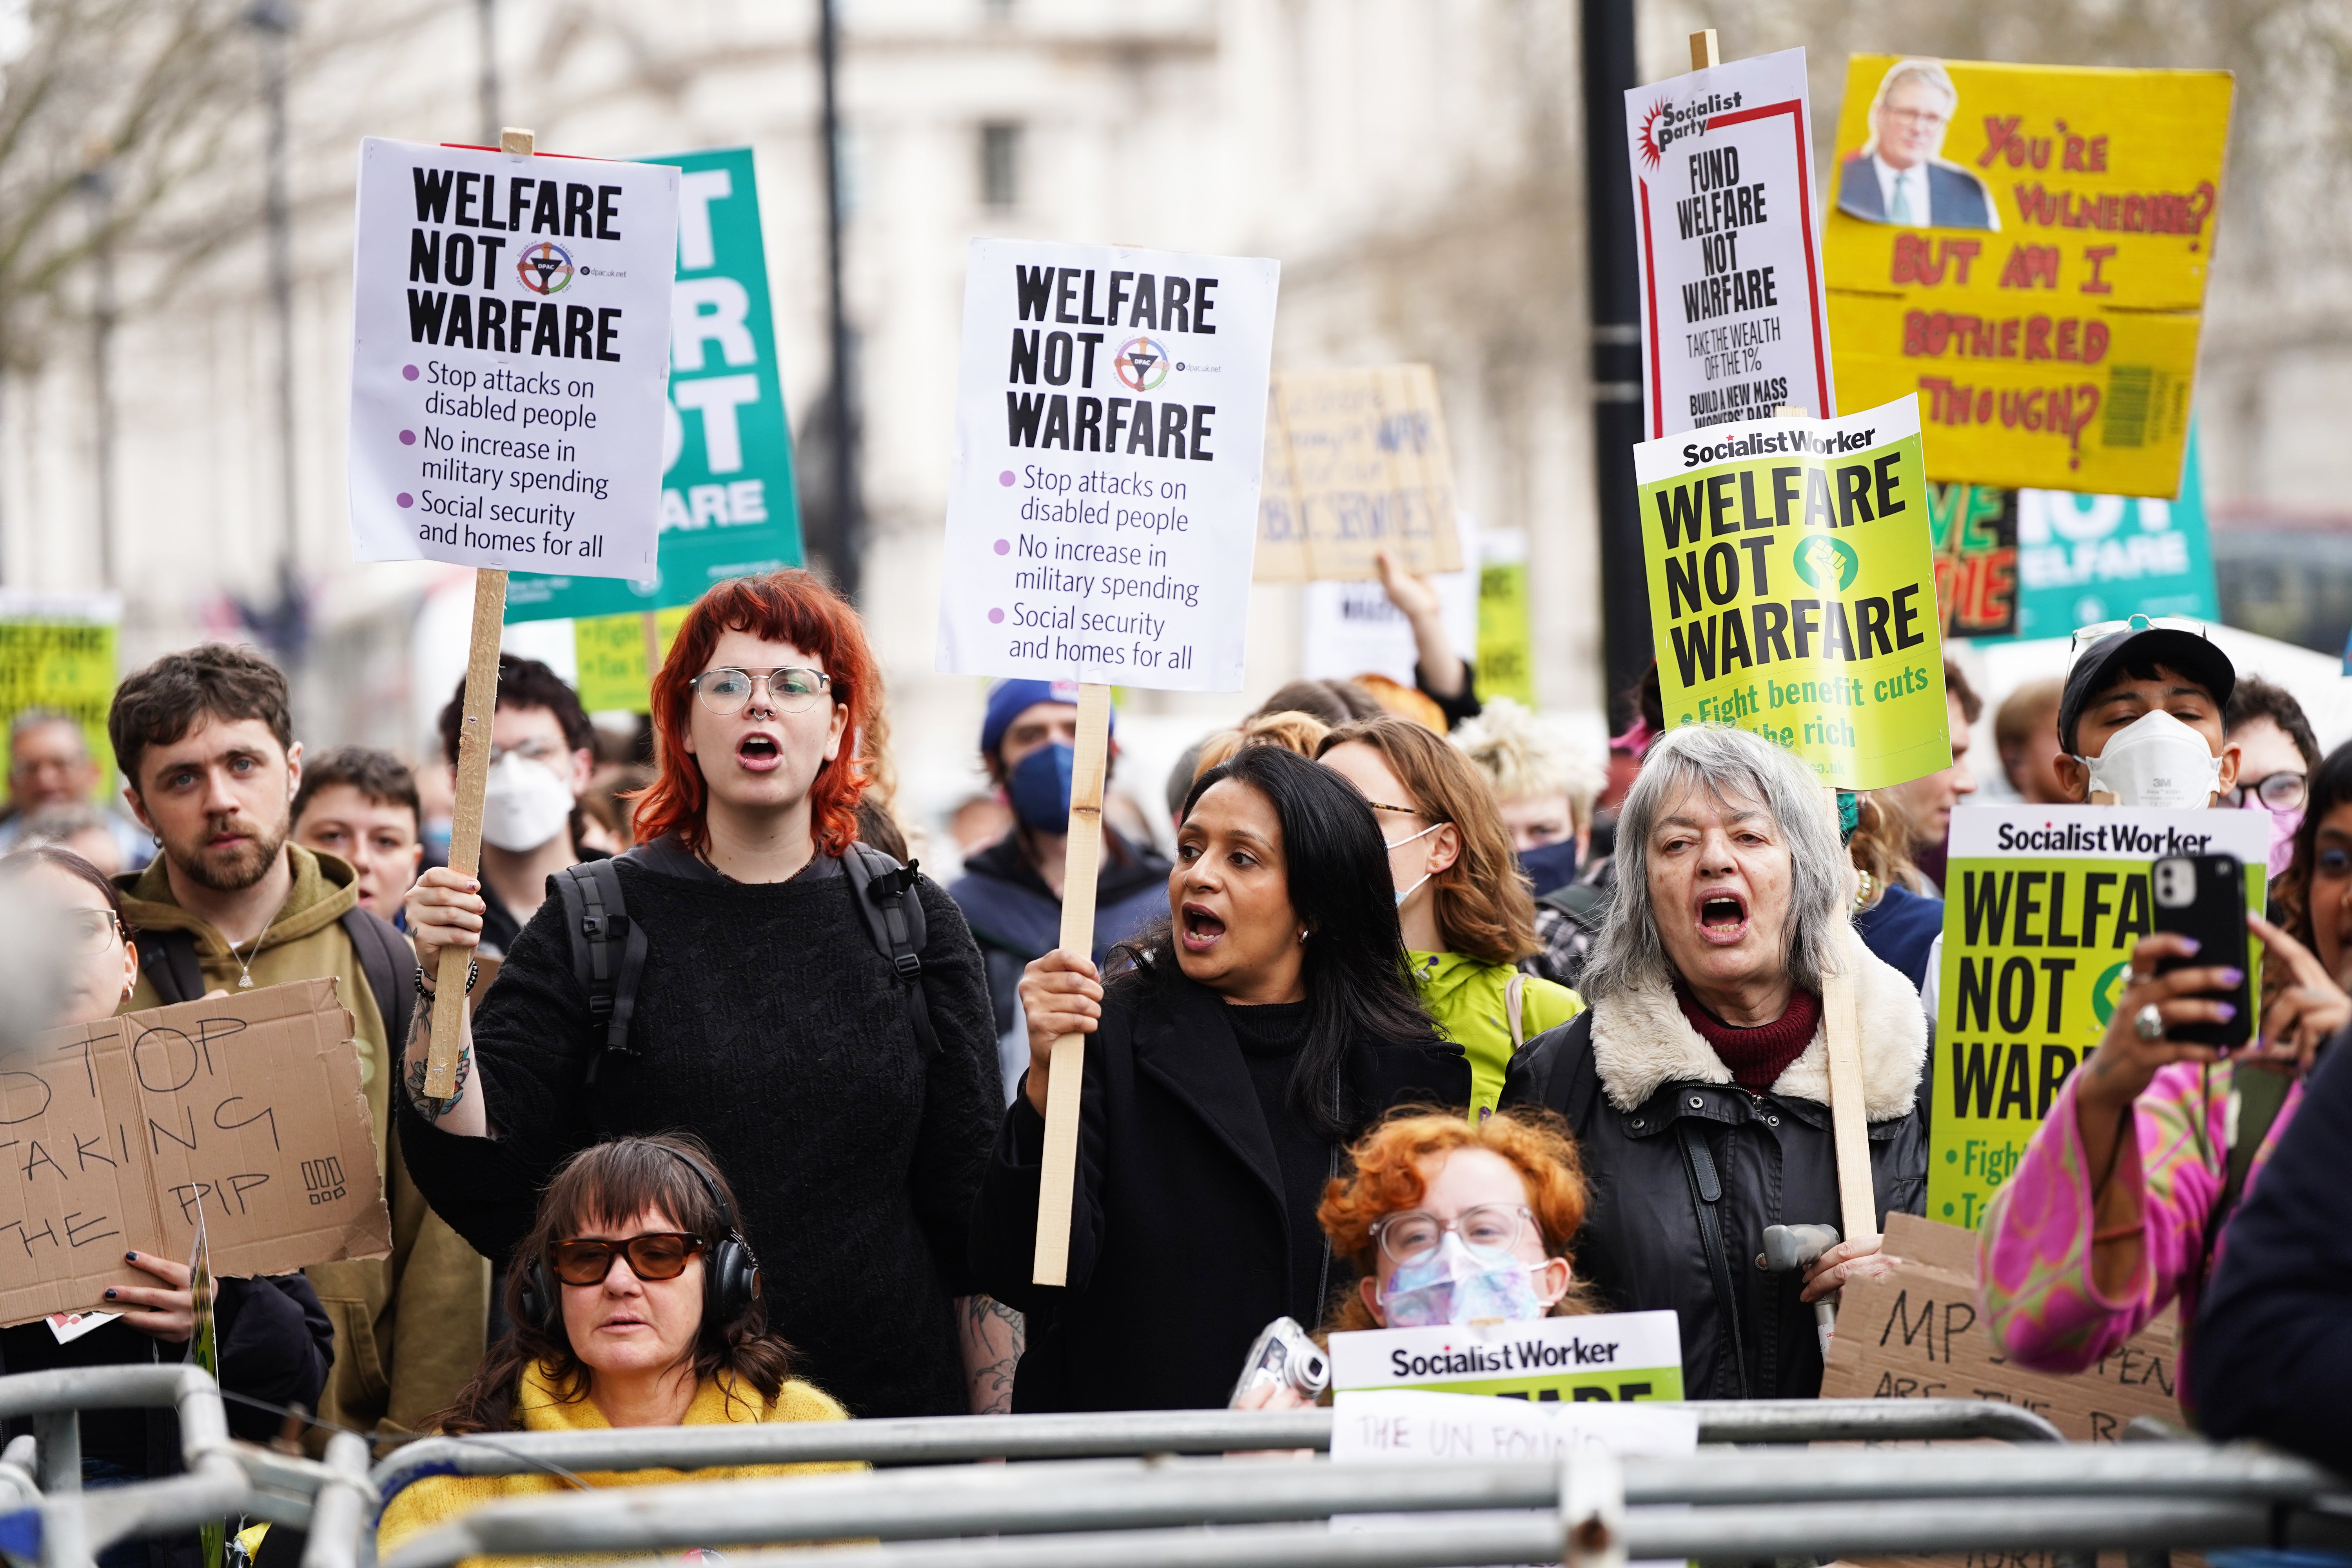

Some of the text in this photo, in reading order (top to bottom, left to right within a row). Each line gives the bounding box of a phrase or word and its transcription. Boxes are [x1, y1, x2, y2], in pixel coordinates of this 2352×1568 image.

[1662, 91, 1742, 127] Socialist
[1658, 118, 1707, 152] Party
[1978, 115, 2108, 172] YOU'RE
[1690, 146, 1739, 194] FUND
[412, 167, 622, 241] WELFARE
[1677, 183, 1767, 240] WELFARE
[409, 229, 506, 290] NOT
[591, 268, 626, 277] dpac.uk.net
[1702, 231, 1737, 276] NOT
[1891, 234, 2117, 294] BUT AM I
[1016, 265, 1218, 334] WELFARE
[1682, 266, 1777, 324] WARFARE
[407, 289, 622, 362] WARFARE
[1686, 316, 1781, 358] TAKE THE WEALTH
[1903, 309, 2109, 365] BOTHERED
[427, 360, 593, 398] Stop attacks on
[1010, 328, 1103, 388] NOT
[1186, 364, 1221, 372] dpac.uk.net
[1705, 346, 1762, 380] OFF THE 1%
[425, 390, 597, 431] disabled people
[1690, 376, 1788, 416] BUILD A NEW MASS
[424, 426, 575, 462] No increase in
[1007, 391, 1215, 461] WARFARE
[1919, 375, 2100, 470] THOUGH?
[422, 458, 609, 500] military spending
[1024, 464, 1186, 499] Stop attacks on
[421, 490, 575, 532] Social security
[1021, 496, 1188, 535] disabled people
[1655, 452, 1906, 550] WELFARE
[419, 523, 603, 558] and homes for all
[1019, 534, 1167, 567] No increase in
[1016, 566, 1200, 607] military spending
[1665, 534, 1775, 620] NOT
[1013, 602, 1165, 641] Social security
[1670, 583, 1924, 689] WARFARE
[1010, 635, 1192, 670] and homes for all
[1698, 666, 1928, 729] Fight benefit cuts
[1804, 715, 1856, 747] rich
[2153, 778, 2171, 787] 3M
[1998, 822, 2109, 853] Socialist
[1963, 871, 2152, 949] WELFA
[1956, 955, 2076, 1034] NOT
[1964, 1138, 2027, 1186] Figh
[169, 1173, 270, 1225] PIP
[1391, 1338, 1619, 1377] Socialist Worker
[1357, 1413, 1411, 1449] THE
[1429, 1419, 1474, 1458] UN
